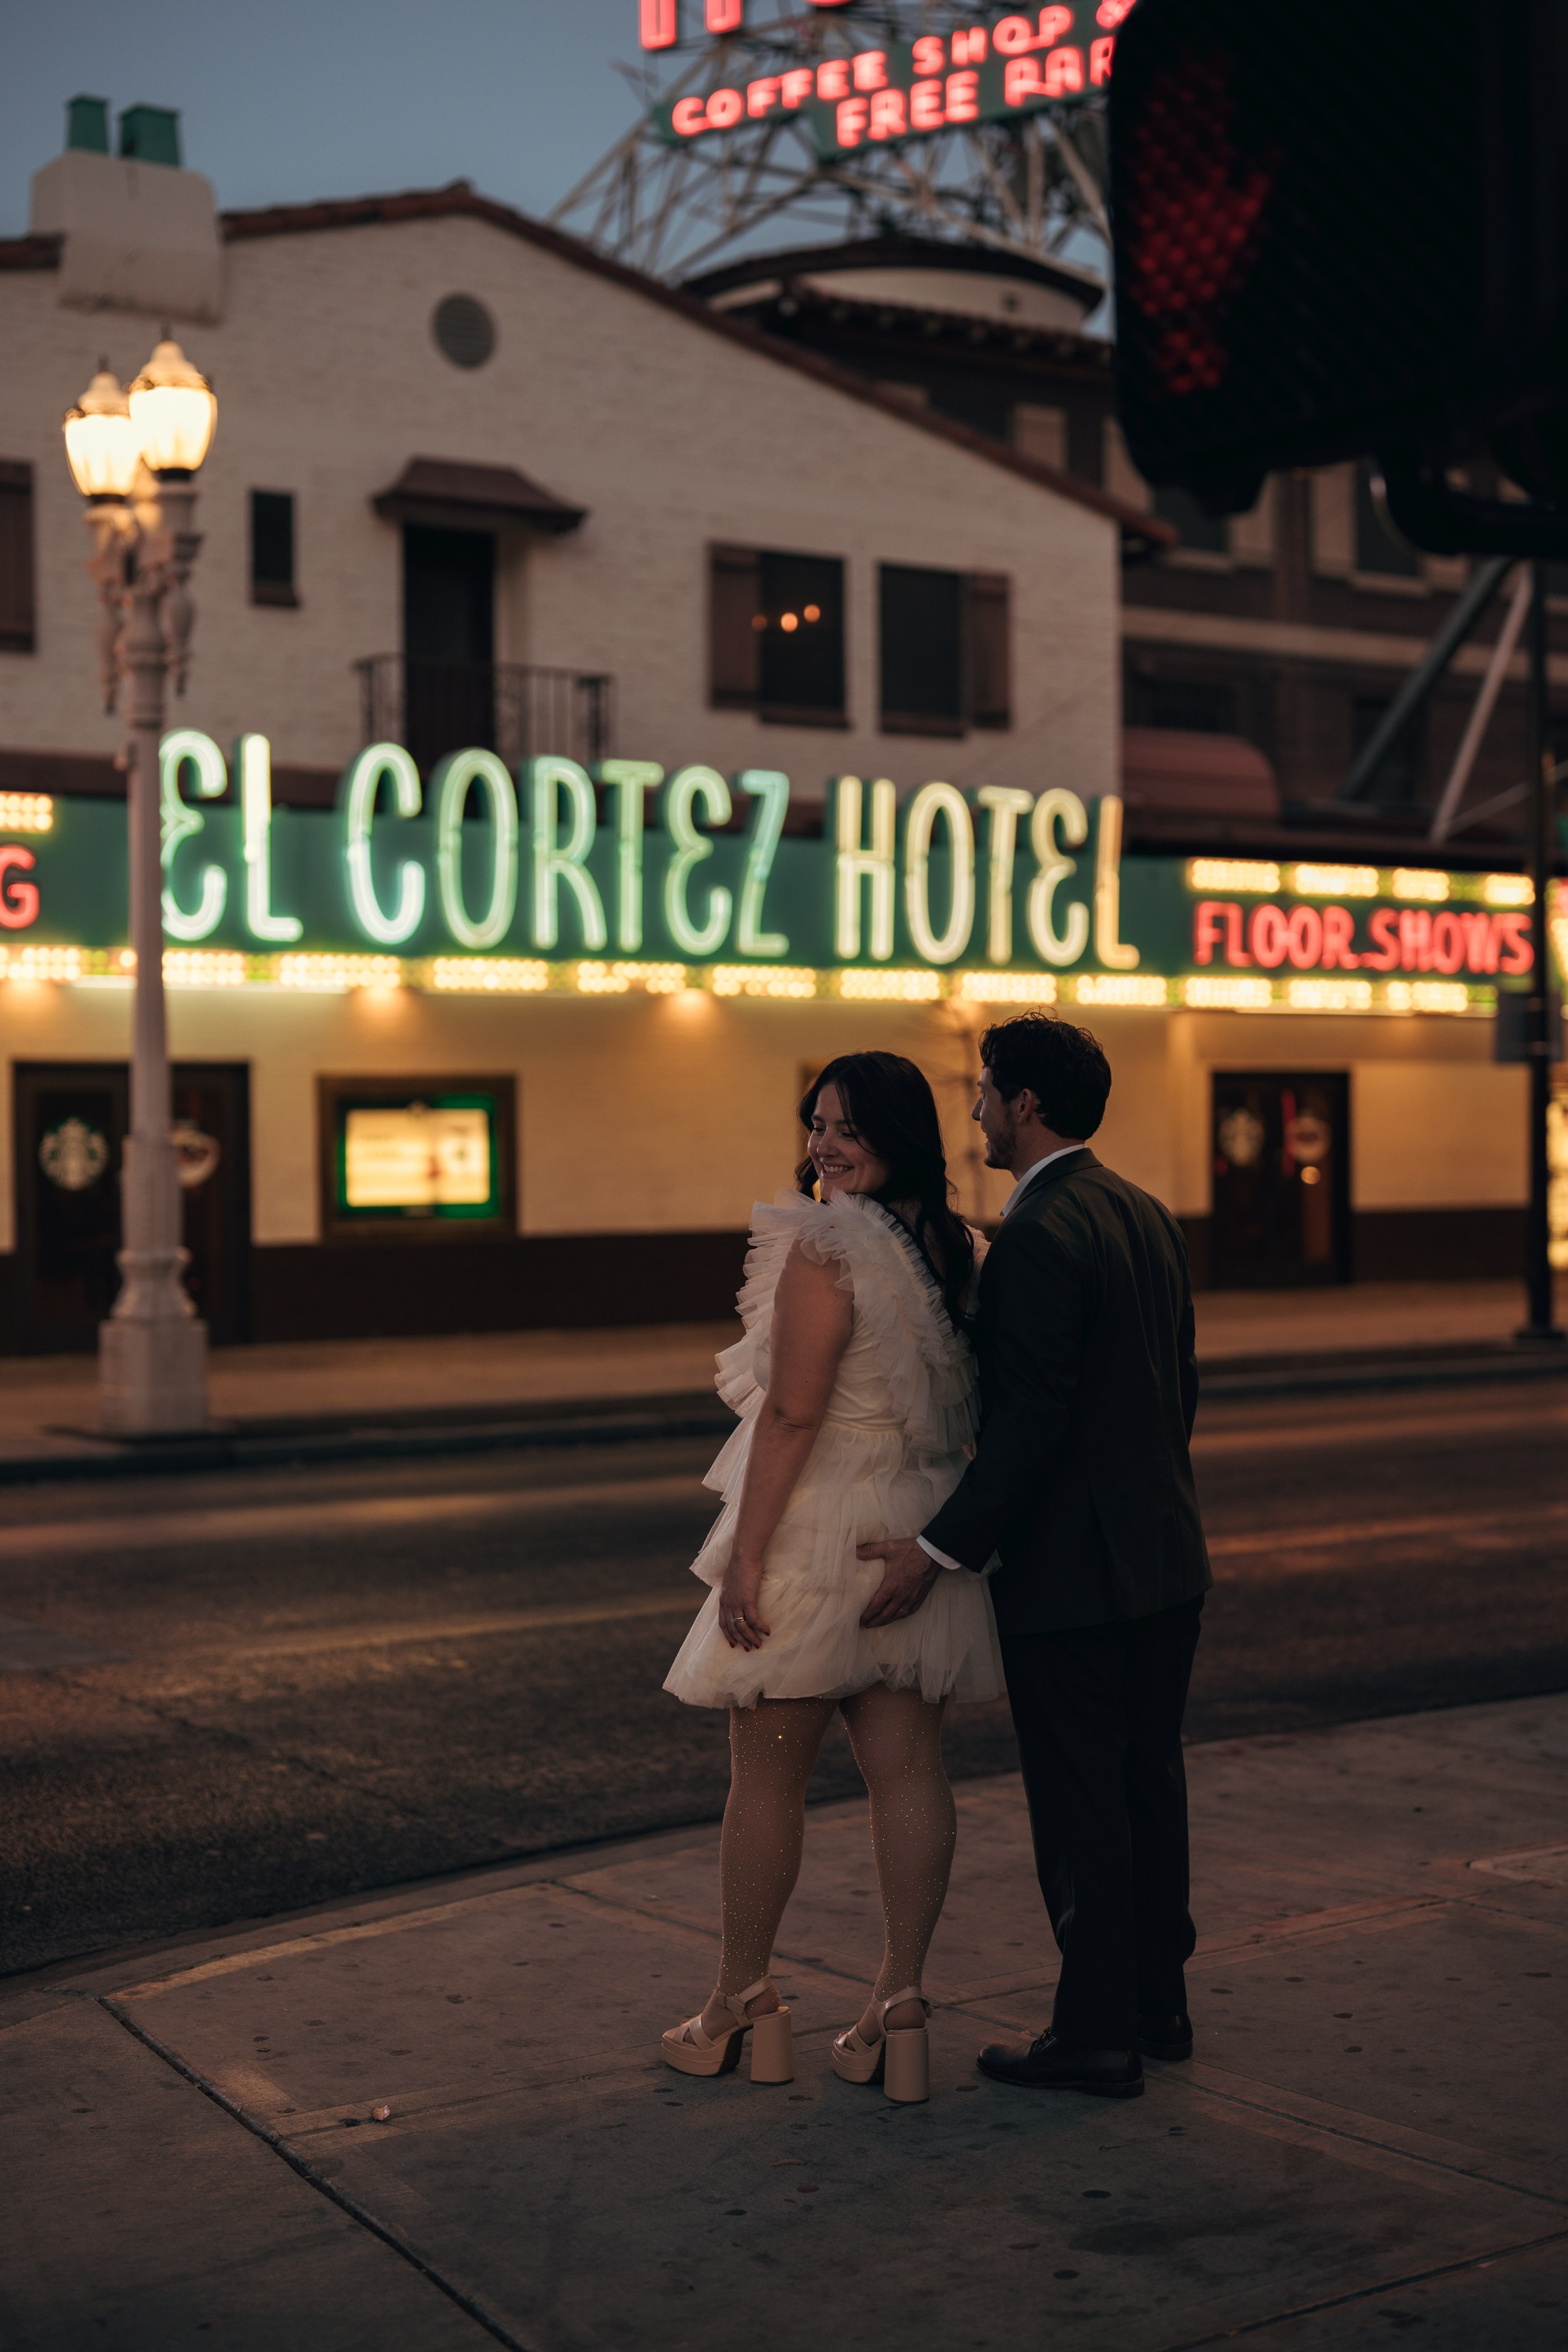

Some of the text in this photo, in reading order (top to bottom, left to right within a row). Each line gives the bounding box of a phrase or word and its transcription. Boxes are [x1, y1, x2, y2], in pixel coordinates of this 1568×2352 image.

[671, 51, 888, 135] COFFEE
[912, 5, 1073, 75] SHOP
[837, 71, 979, 147] FREE
[160, 728, 1140, 970] EL CORTEZ HOTEL
[1193, 901, 1535, 976] FLOOR SHOWS
